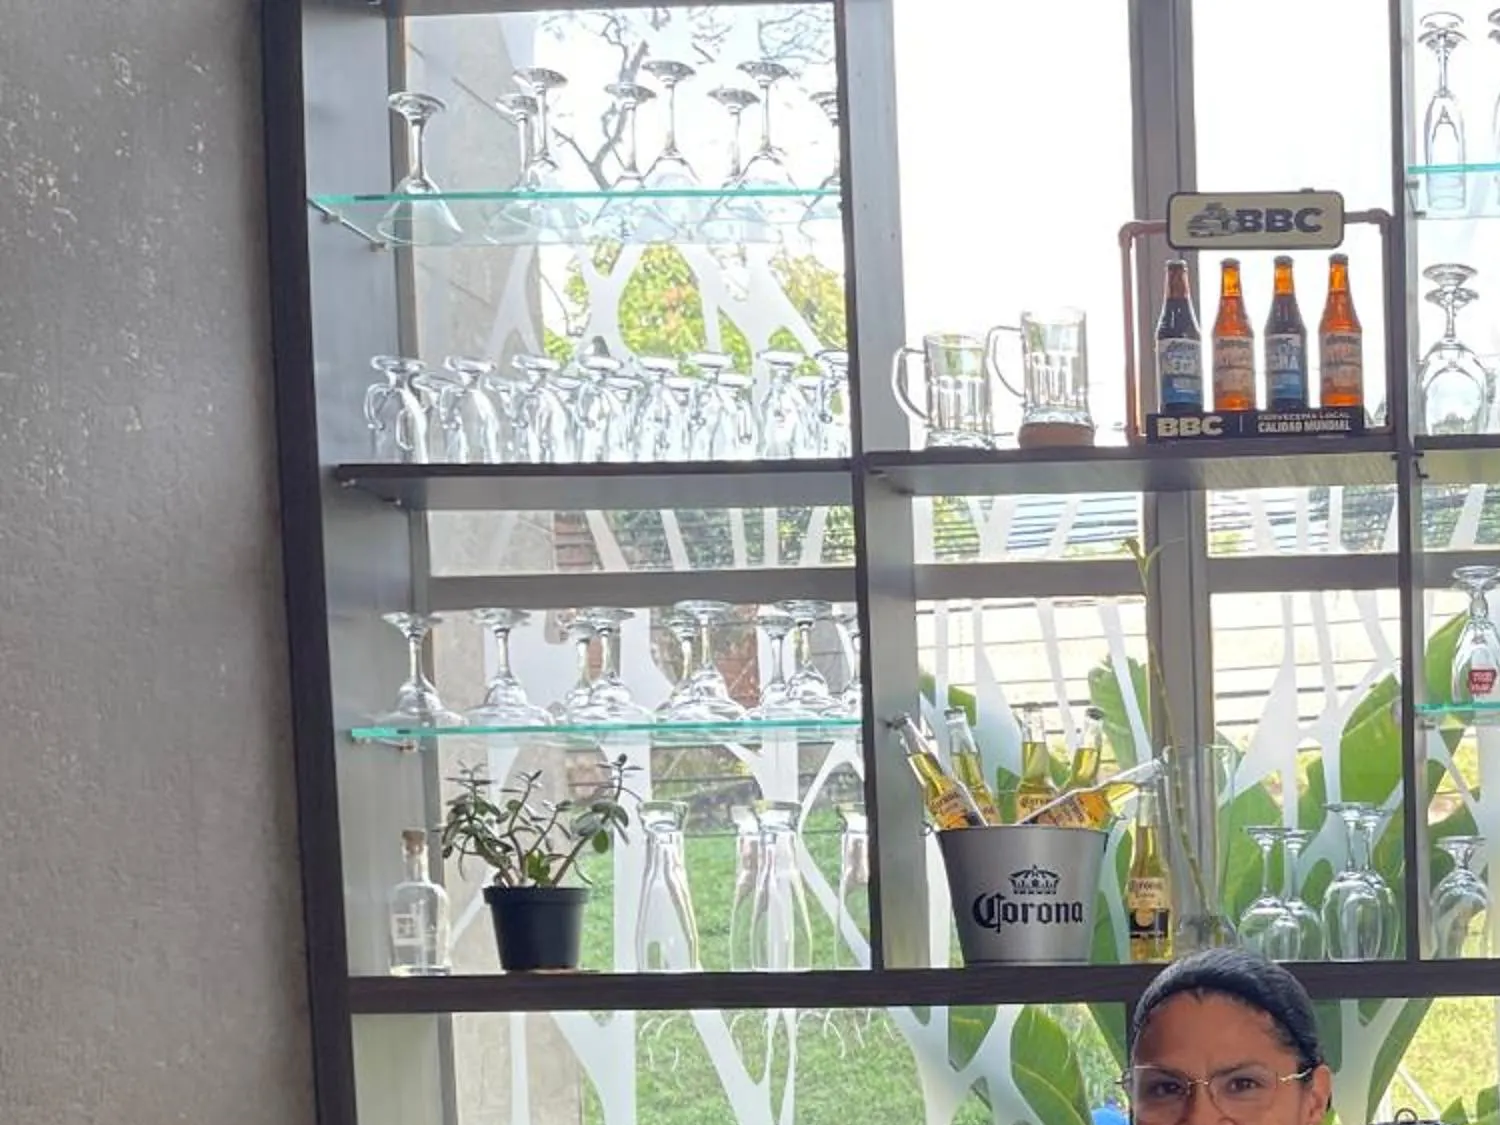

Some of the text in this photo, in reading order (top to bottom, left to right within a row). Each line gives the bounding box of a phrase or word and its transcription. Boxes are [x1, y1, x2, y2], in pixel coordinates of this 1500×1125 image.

[1236, 207, 1322, 233] BBC
[1157, 415, 1223, 437] BBC
[1258, 418, 1352, 433] CALIDAD MUNDIAL
[972, 893, 1084, 933] Corona
